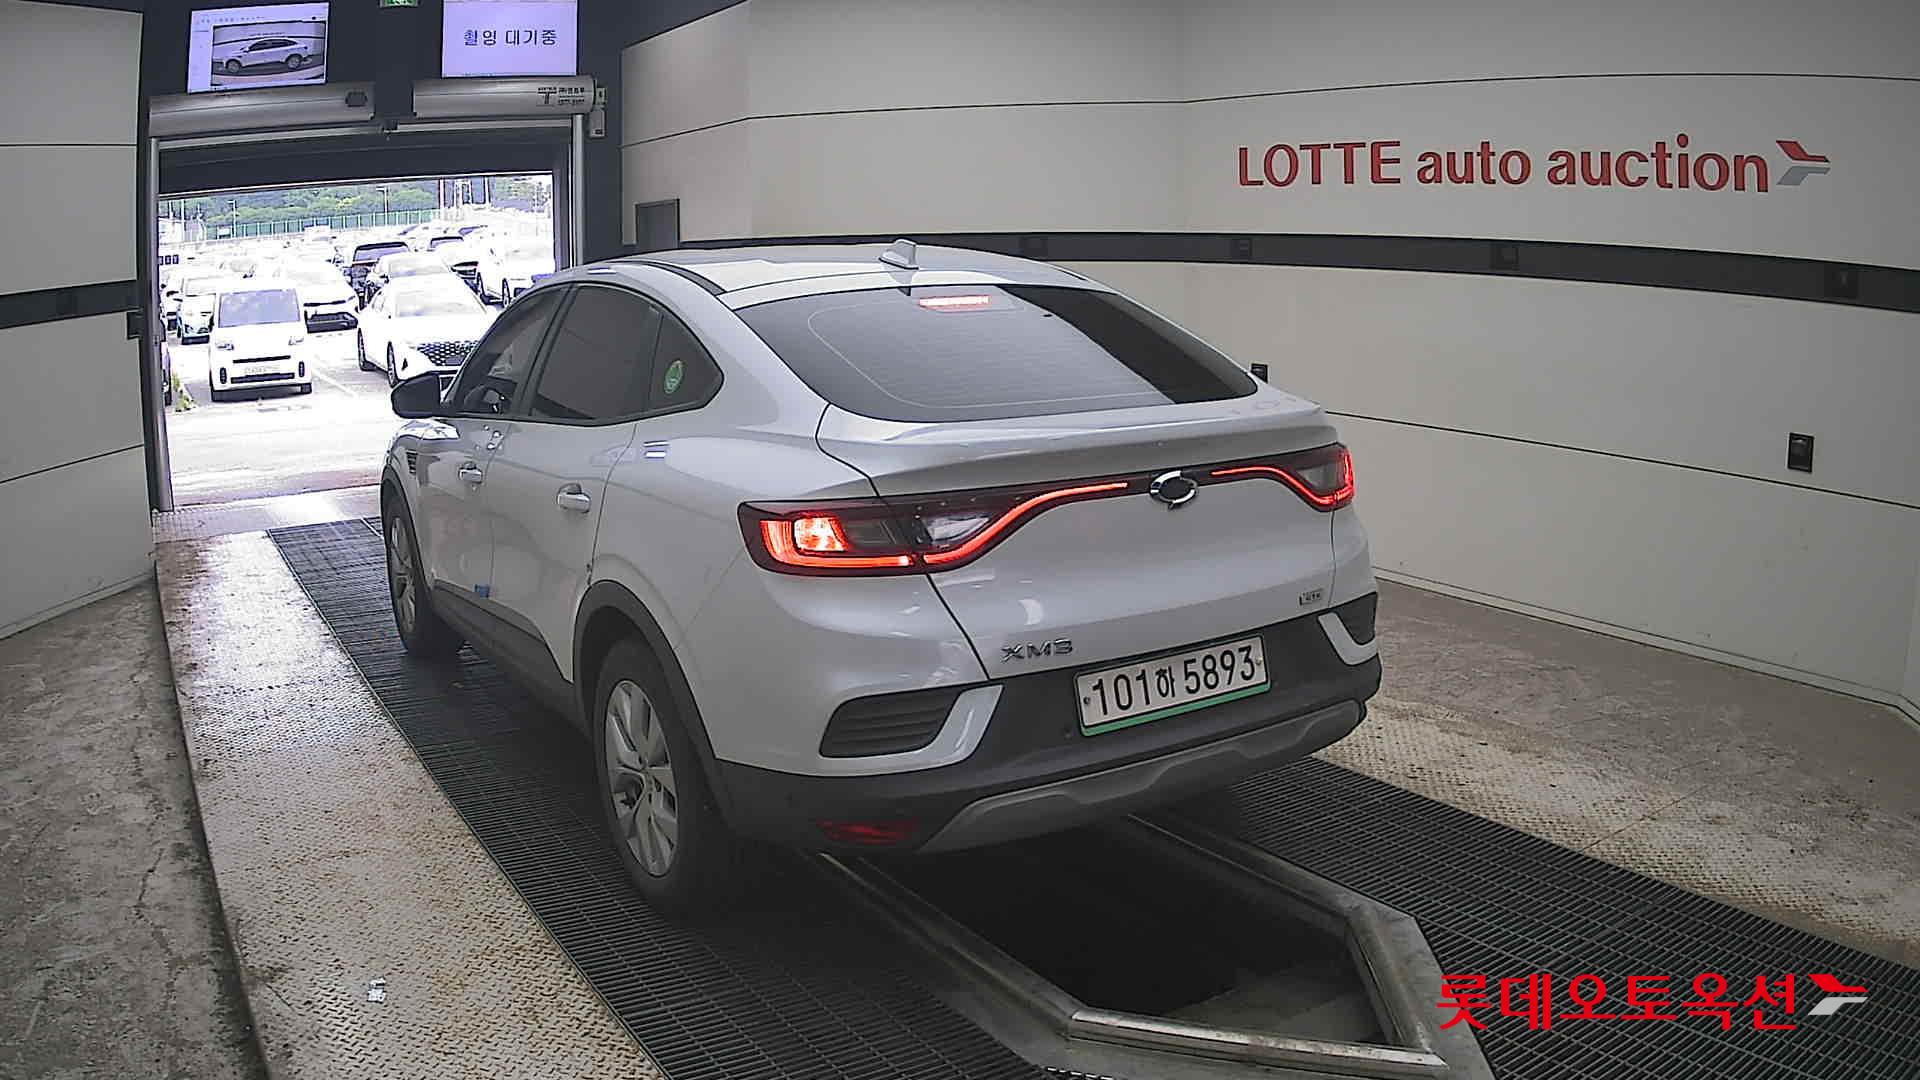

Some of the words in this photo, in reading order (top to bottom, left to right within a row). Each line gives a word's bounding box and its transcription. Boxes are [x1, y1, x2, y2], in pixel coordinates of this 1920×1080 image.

[505, 29, 556, 46] 대기중
[1238, 140, 1401, 187] LOTTE
[1416, 140, 1531, 185] auto
[1547, 134, 1769, 193] auction
[1000, 637, 1074, 663] XM3
